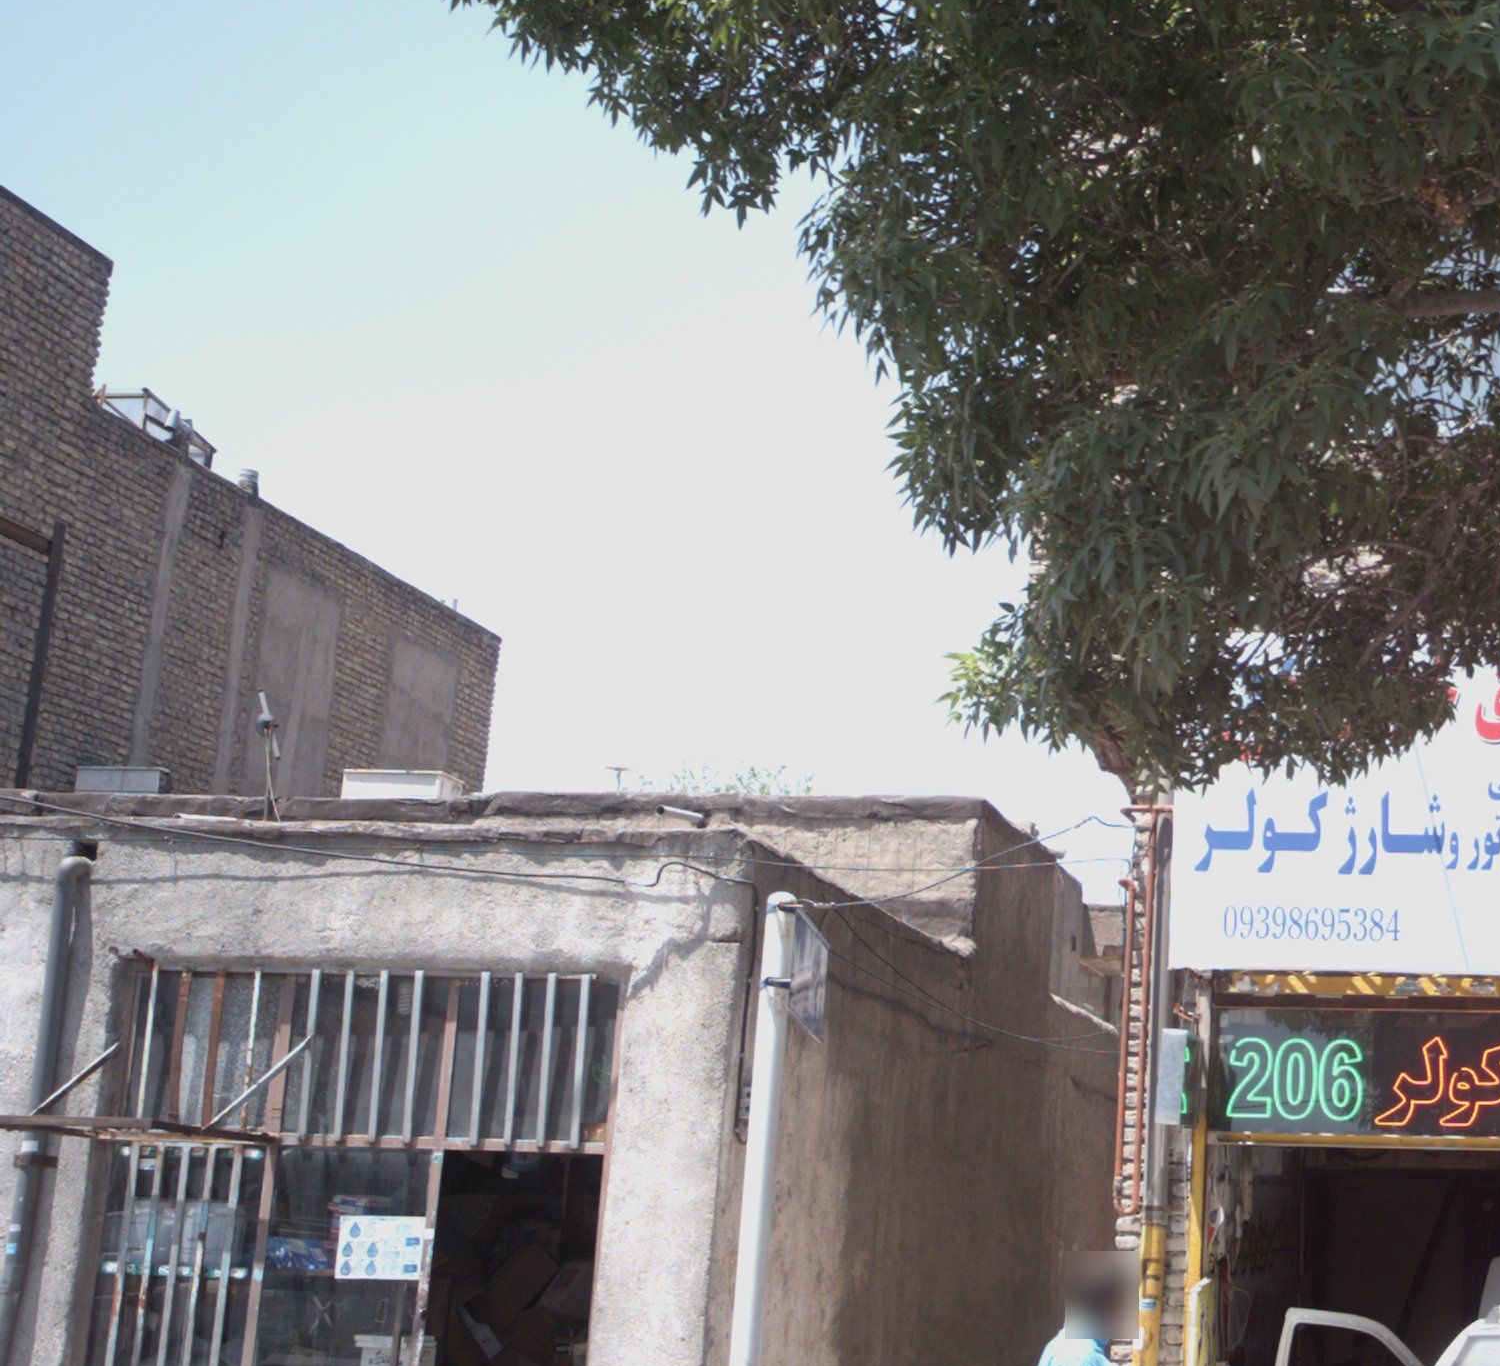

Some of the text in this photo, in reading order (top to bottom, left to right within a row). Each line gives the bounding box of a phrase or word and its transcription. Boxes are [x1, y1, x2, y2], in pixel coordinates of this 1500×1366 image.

[1194, 788, 1329, 873] کولر
[1223, 905, 1400, 942] 09398695384
[1226, 1035, 1364, 1122] 206
